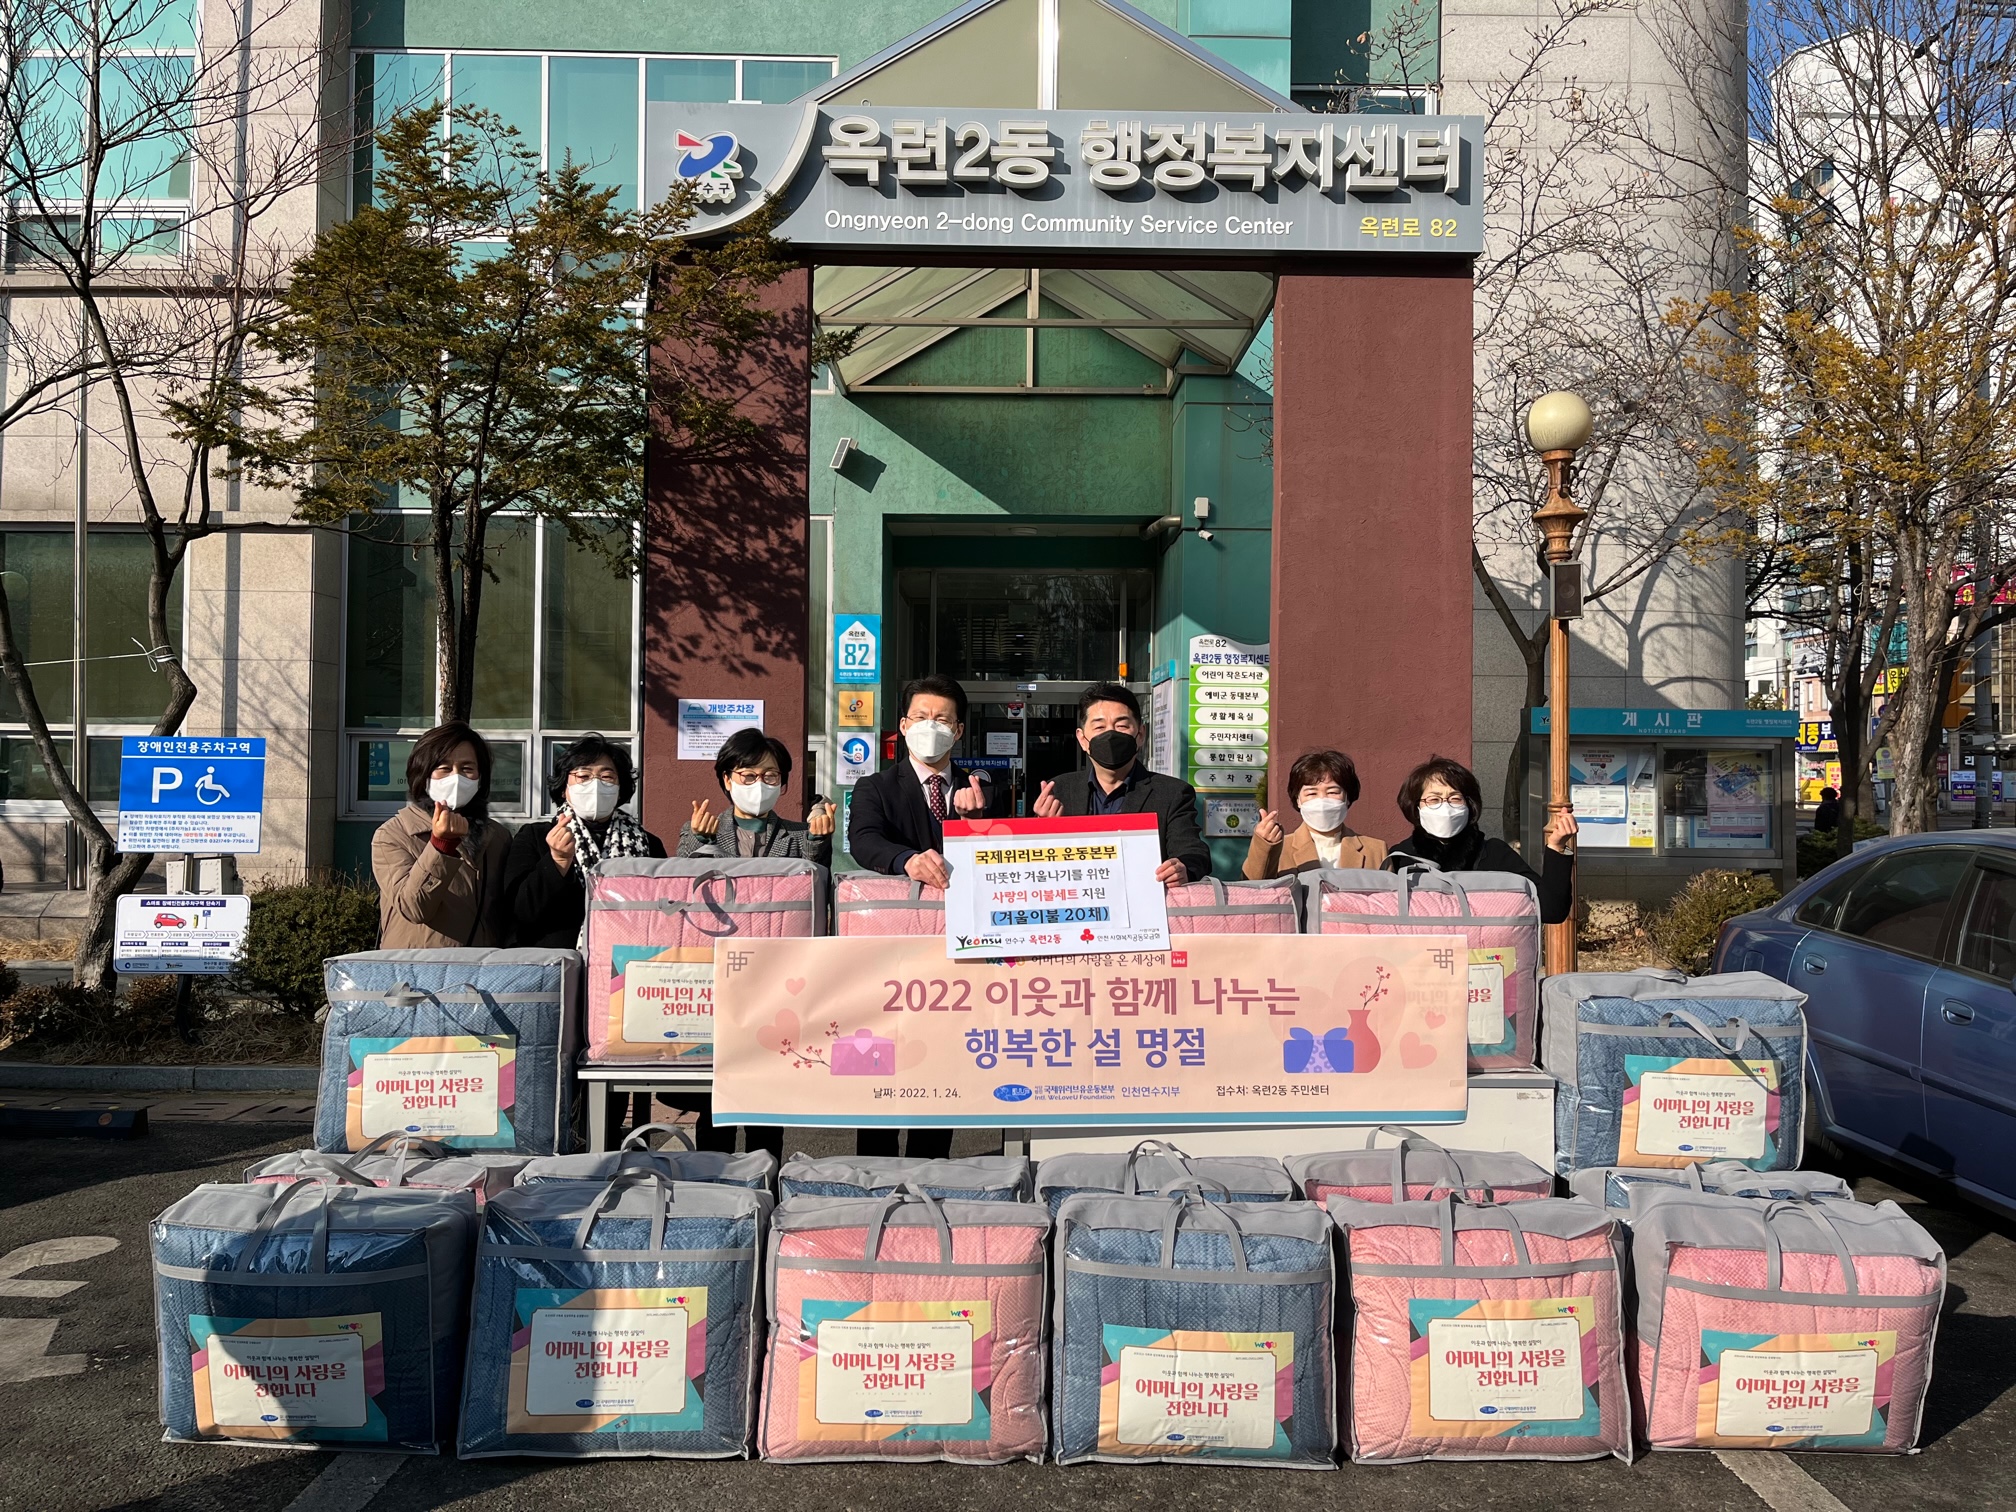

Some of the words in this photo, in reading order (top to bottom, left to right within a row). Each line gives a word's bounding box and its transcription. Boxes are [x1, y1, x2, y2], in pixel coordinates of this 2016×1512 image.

[822, 115, 1055, 189] 옥련2동
[1081, 118, 1460, 195] 행정복지센터
[824, 209, 930, 232] Ongnyeon
[936, 211, 1014, 234] 2-dong
[1021, 213, 1134, 235] Community
[1140, 214, 1218, 235] Service
[1225, 215, 1294, 235] Center
[1359, 217, 1422, 239] 옥련로
[1430, 218, 1458, 237] 82
[1215, 639, 1227, 648] 82
[844, 643, 870, 666] 82
[1192, 652, 1222, 665] 옥련2동
[1201, 671, 1224, 680] 어린이
[1226, 671, 1264, 680] 작은도서관
[1204, 691, 1228, 700] 예비군
[1229, 691, 1260, 700] 동대본부
[707, 703, 755, 714] 개방주차장
[1209, 712, 1254, 721] 생활체육실
[1209, 732, 1254, 742] 주민자치센터
[137, 741, 251, 754] 장애인전용주차구역
[1209, 753, 1253, 763] 통합민원실
[151, 766, 183, 804] P
[975, 848, 1059, 864] 국제위러브유
[1061, 846, 1117, 861] 운동본부
[985, 871, 1022, 884] 따뜻한
[1024, 869, 1083, 883] 겨울나기를
[1086, 867, 1110, 881] 위한
[992, 890, 1028, 904] 사랑의
[1031, 888, 1080, 902] 이불세트
[1082, 887, 1106, 900] 지원
[992, 909, 1060, 926] (겨울이불
[1064, 906, 1109, 921] 20채)
[955, 934, 1002, 949] Yeonsu
[1004, 937, 1025, 945] 연수구
[1029, 934, 1062, 945] 옥련2동
[1031, 955, 1076, 967] 어머니의
[1079, 953, 1115, 968] 사랑을
[1116, 953, 1129, 967] 온
[1131, 953, 1166, 967] 세상에
[636, 986, 694, 1001] 어머니의
[882, 979, 972, 1012] 2022
[984, 976, 1096, 1017] 이웃과
[1106, 976, 1177, 1016] 함께
[1191, 976, 1300, 1016] 나누는
[662, 1003, 715, 1016] 전합니다
[964, 1027, 1077, 1069] 행복한
[1087, 1027, 1122, 1068] 설
[1136, 1026, 1206, 1068] 명절
[375, 1078, 435, 1094] 어머니의
[439, 1077, 485, 1093] 사랑을
[873, 1087, 896, 1099] 날짜:
[1044, 1084, 1115, 1094] 국제위러브유운동본부
[1121, 1085, 1181, 1098] 인천연수지부
[1215, 1085, 1249, 1096] 접수처:
[1251, 1085, 1288, 1096] 옥련2동
[1290, 1084, 1329, 1096] 주민센터
[402, 1095, 457, 1110] 전합니다
[1653, 1098, 1710, 1115] 어머니의
[1714, 1100, 1756, 1116] 사랑을
[1678, 1115, 1731, 1130] 전합니다
[545, 1341, 613, 1360] 어머니의
[617, 1340, 671, 1359] 사랑을
[1445, 1350, 1513, 1368] 어머니의
[1518, 1349, 1567, 1368] 사랑을
[574, 1361, 639, 1379] 전합니다
[832, 1353, 900, 1371] 어머니의
[905, 1353, 956, 1371] 사랑을
[223, 1363, 289, 1381] 어머니의
[295, 1362, 347, 1381] 사랑을
[1477, 1370, 1539, 1387] 전합니다
[254, 1382, 317, 1398] 전합니다
[862, 1373, 926, 1390] 전합니다
[1135, 1378, 1203, 1400] 어머니의
[1208, 1382, 1260, 1401] 사랑을
[1735, 1377, 1805, 1394] 어머니의
[1810, 1376, 1861, 1394] 사랑을
[1166, 1400, 1230, 1418] 전합니다
[1766, 1395, 1829, 1410] 전합니다
